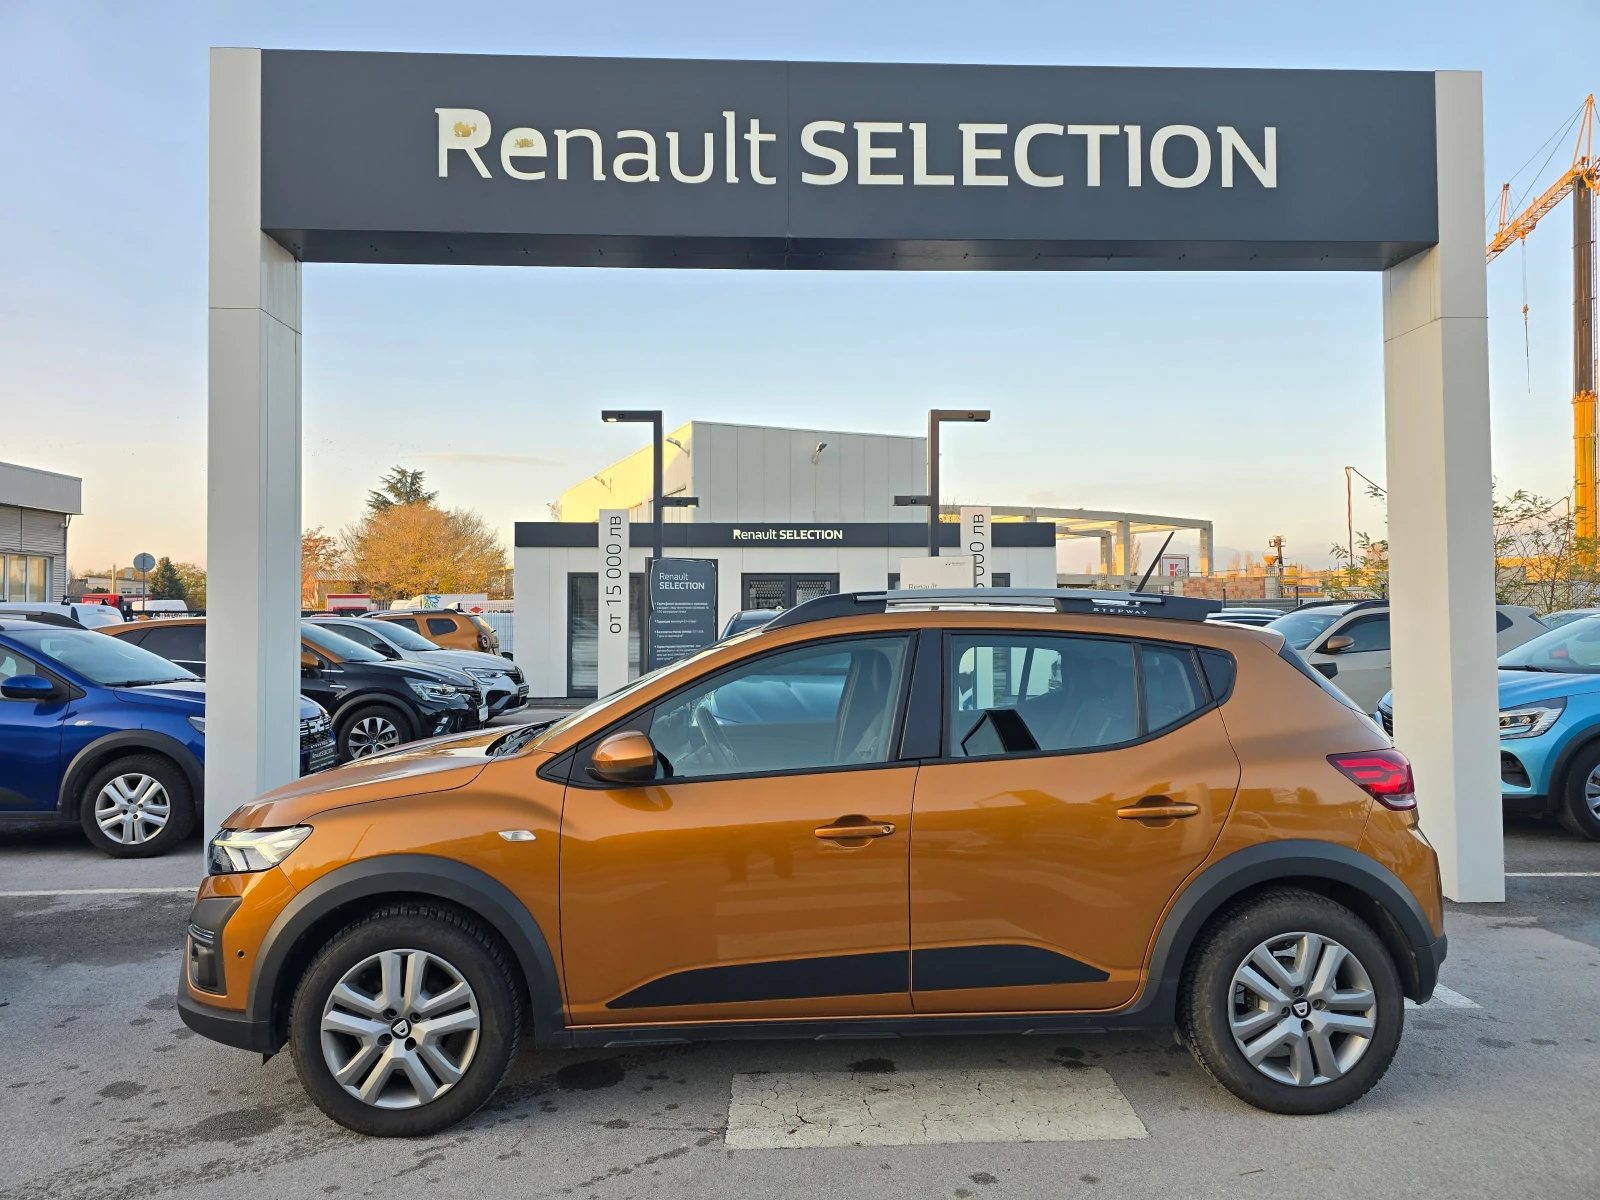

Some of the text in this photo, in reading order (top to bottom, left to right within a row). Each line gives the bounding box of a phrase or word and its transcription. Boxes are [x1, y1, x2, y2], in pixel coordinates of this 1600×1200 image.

[435, 107, 1278, 190] Renault SELECTION
[732, 528, 843, 540] Renault SELECTION
[606, 543, 622, 579] 000
[659, 572, 689, 581] Renault
[659, 581, 705, 590] SELECTION
[606, 585, 622, 607] 15
[1092, 607, 1148, 615] STEPWAY
